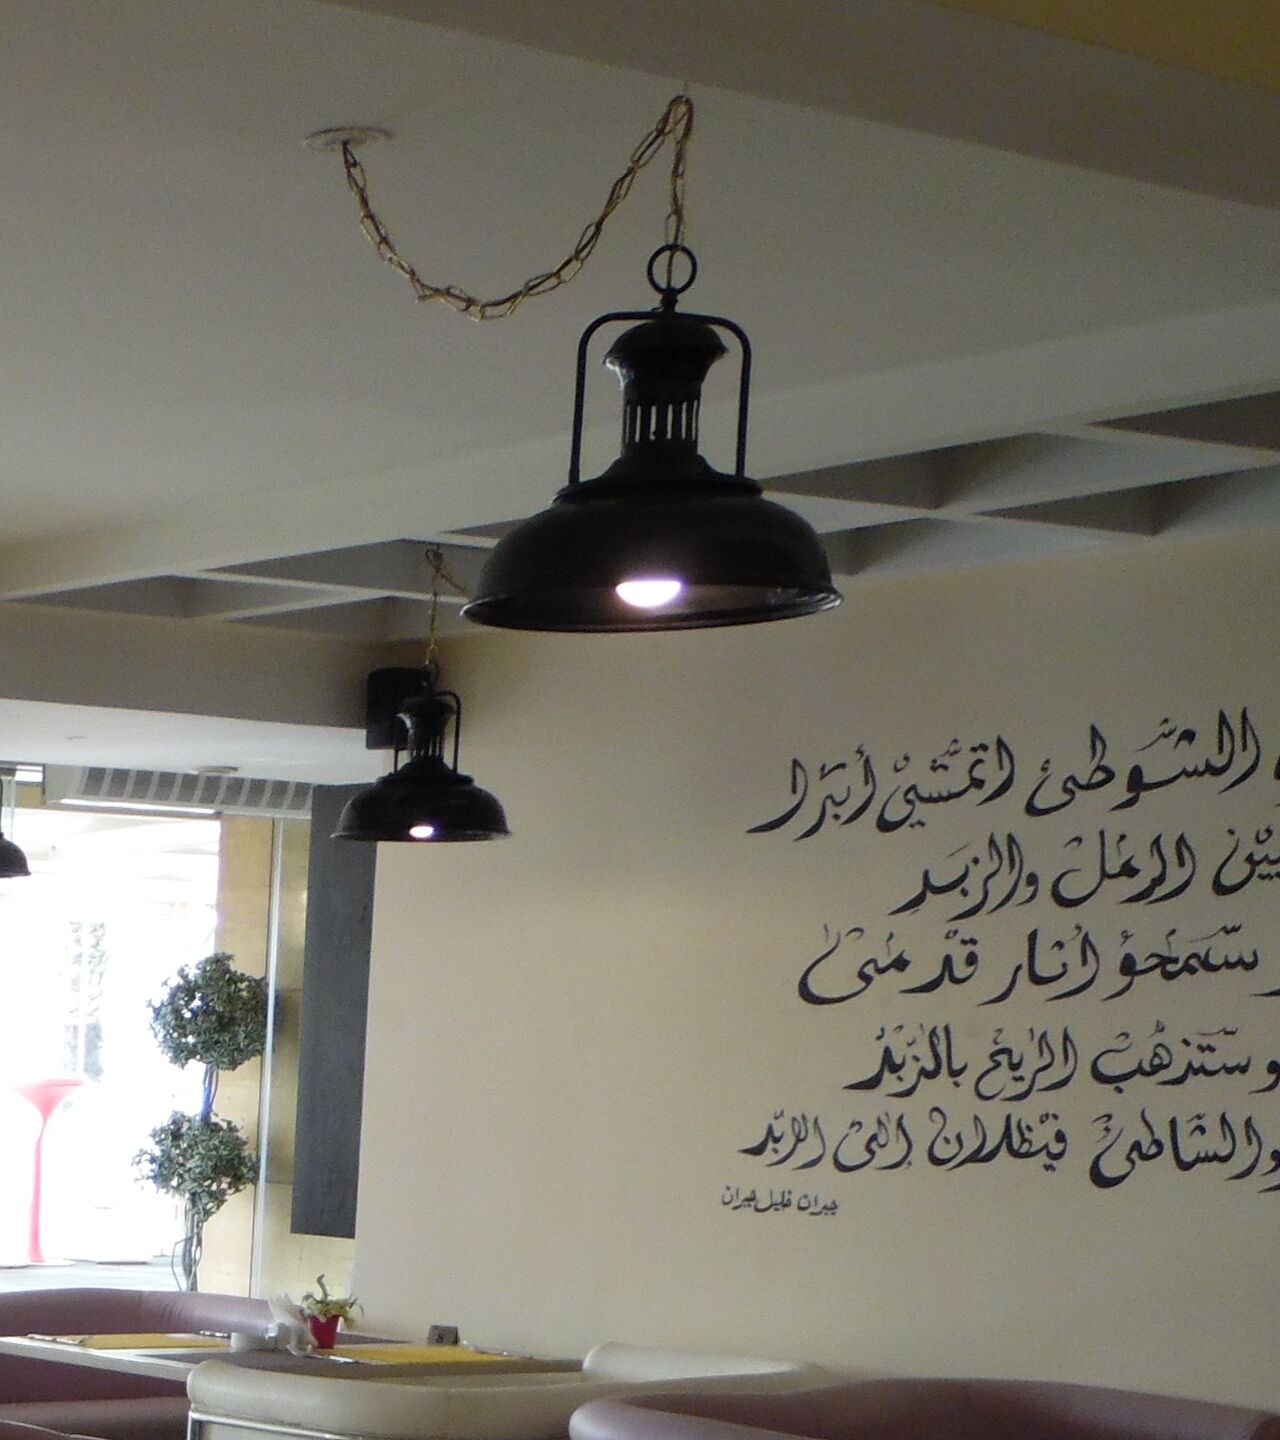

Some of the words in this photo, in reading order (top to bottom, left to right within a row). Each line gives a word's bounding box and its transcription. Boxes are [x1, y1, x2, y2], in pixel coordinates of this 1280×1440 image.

[888, 832, 1039, 923] والزبد
[1050, 829, 1196, 909] الرمل
[842, 1023, 968, 1099] بالزبد
[974, 1026, 1078, 1102] الريح
